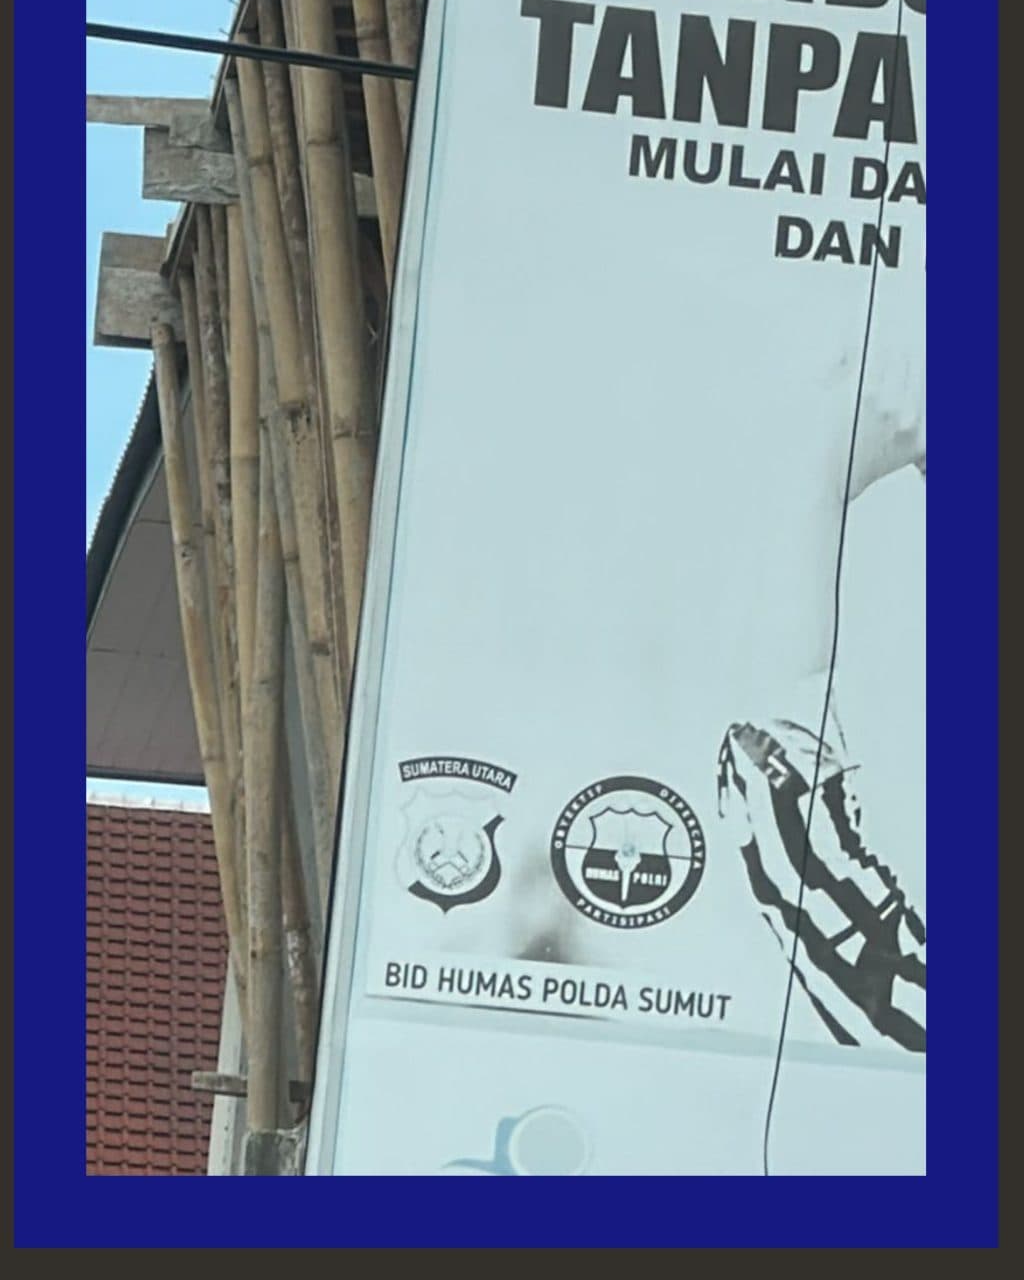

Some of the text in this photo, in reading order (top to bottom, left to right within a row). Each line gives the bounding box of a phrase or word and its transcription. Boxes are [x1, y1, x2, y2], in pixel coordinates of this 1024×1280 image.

[629, 134, 826, 195] MULAI
[775, 215, 901, 268] DAN
[402, 760, 512, 789] SUMATERA UTARA
[385, 962, 731, 1020] BID HUMAS POLDA SUMUT
